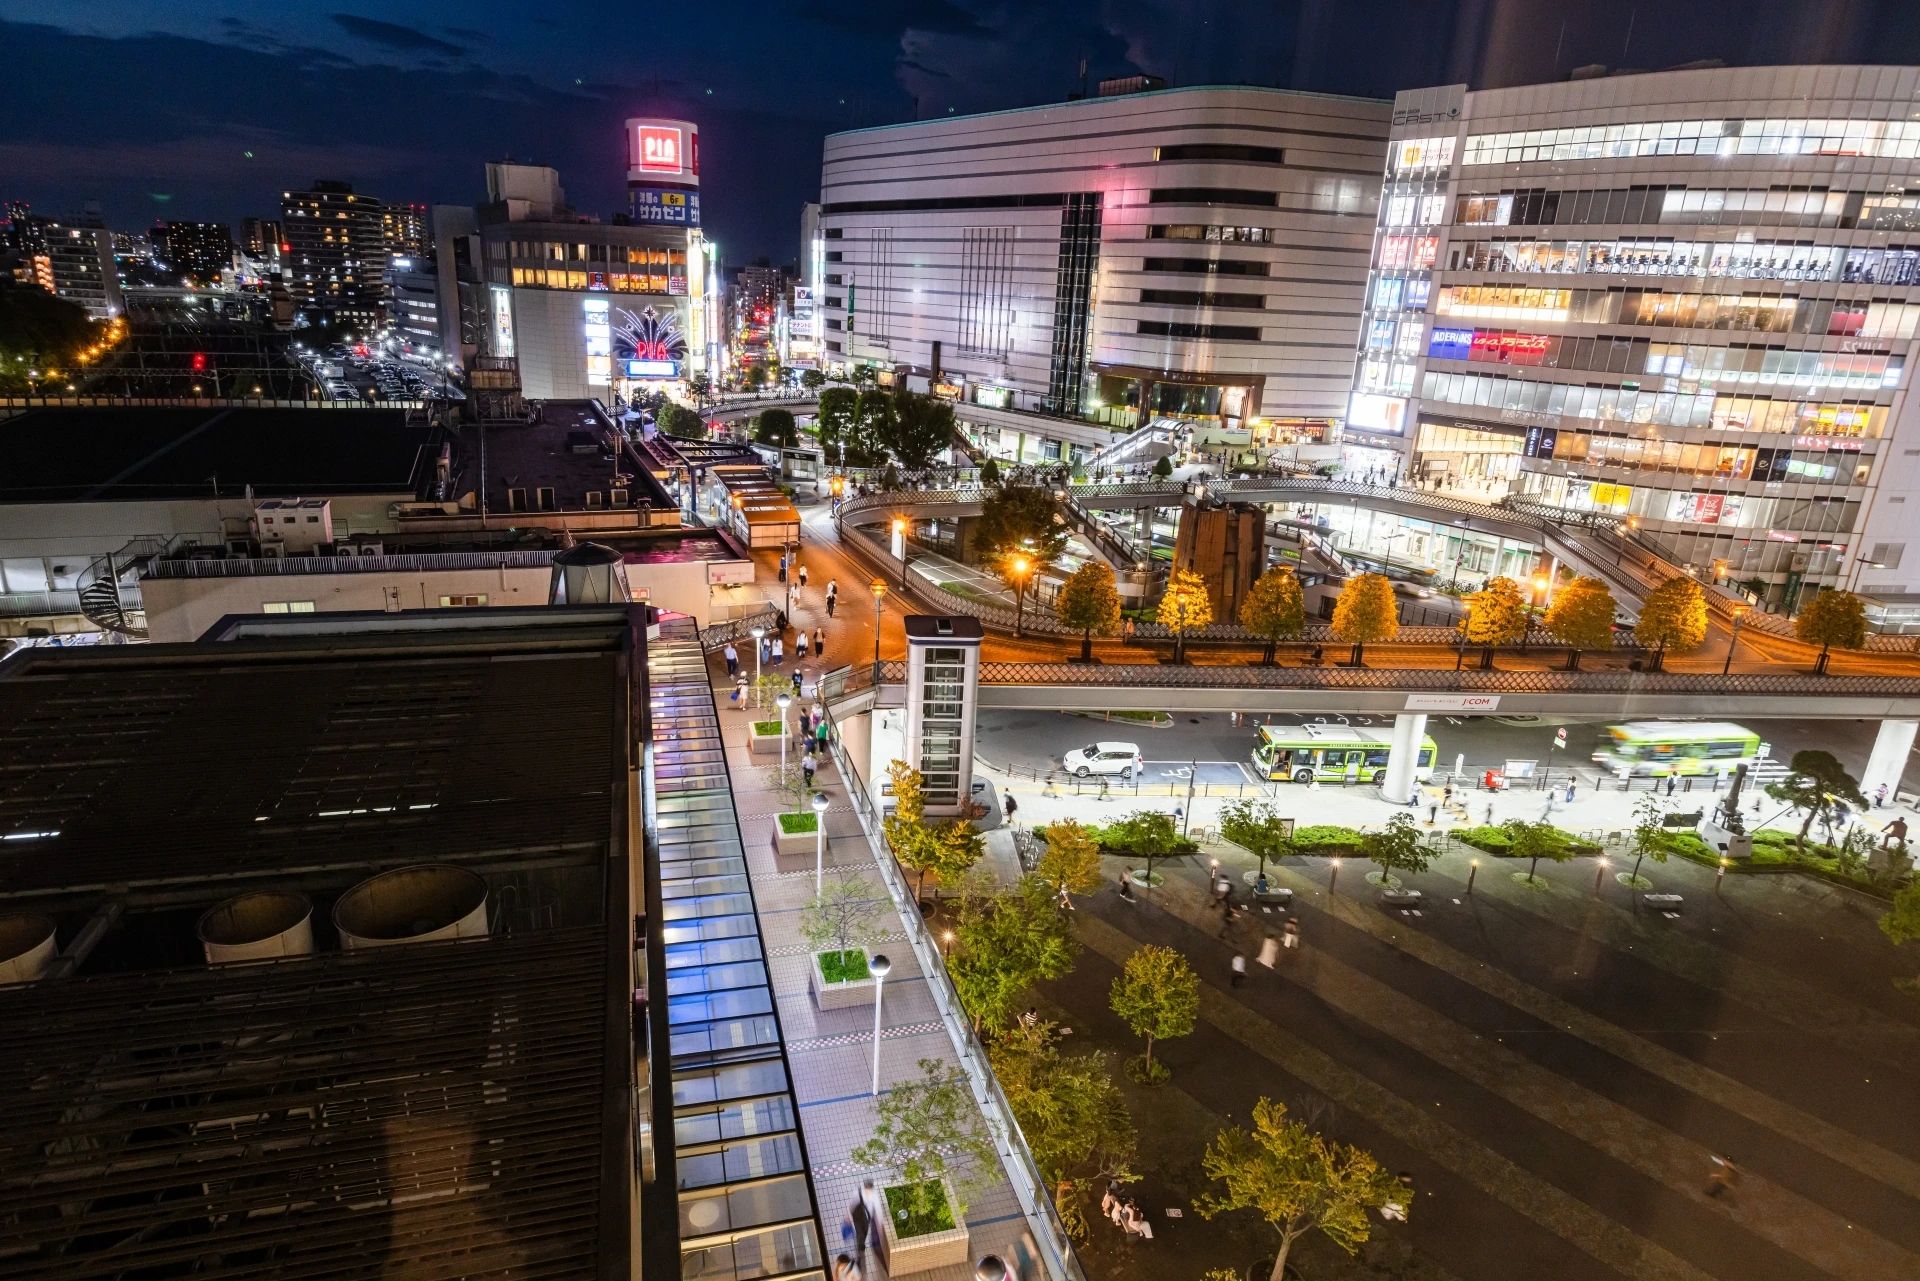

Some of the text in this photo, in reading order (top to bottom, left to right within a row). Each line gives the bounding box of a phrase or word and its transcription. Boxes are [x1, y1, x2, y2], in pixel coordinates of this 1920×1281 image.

[1393, 110, 1460, 125] CASTY
[645, 136, 675, 158] PIA
[669, 194, 679, 205] 6F
[640, 206, 685, 220] サカゼン
[1433, 331, 1473, 345] ADERANS
[637, 341, 667, 359] PIA
[1462, 698, 1490, 706] J:COM
